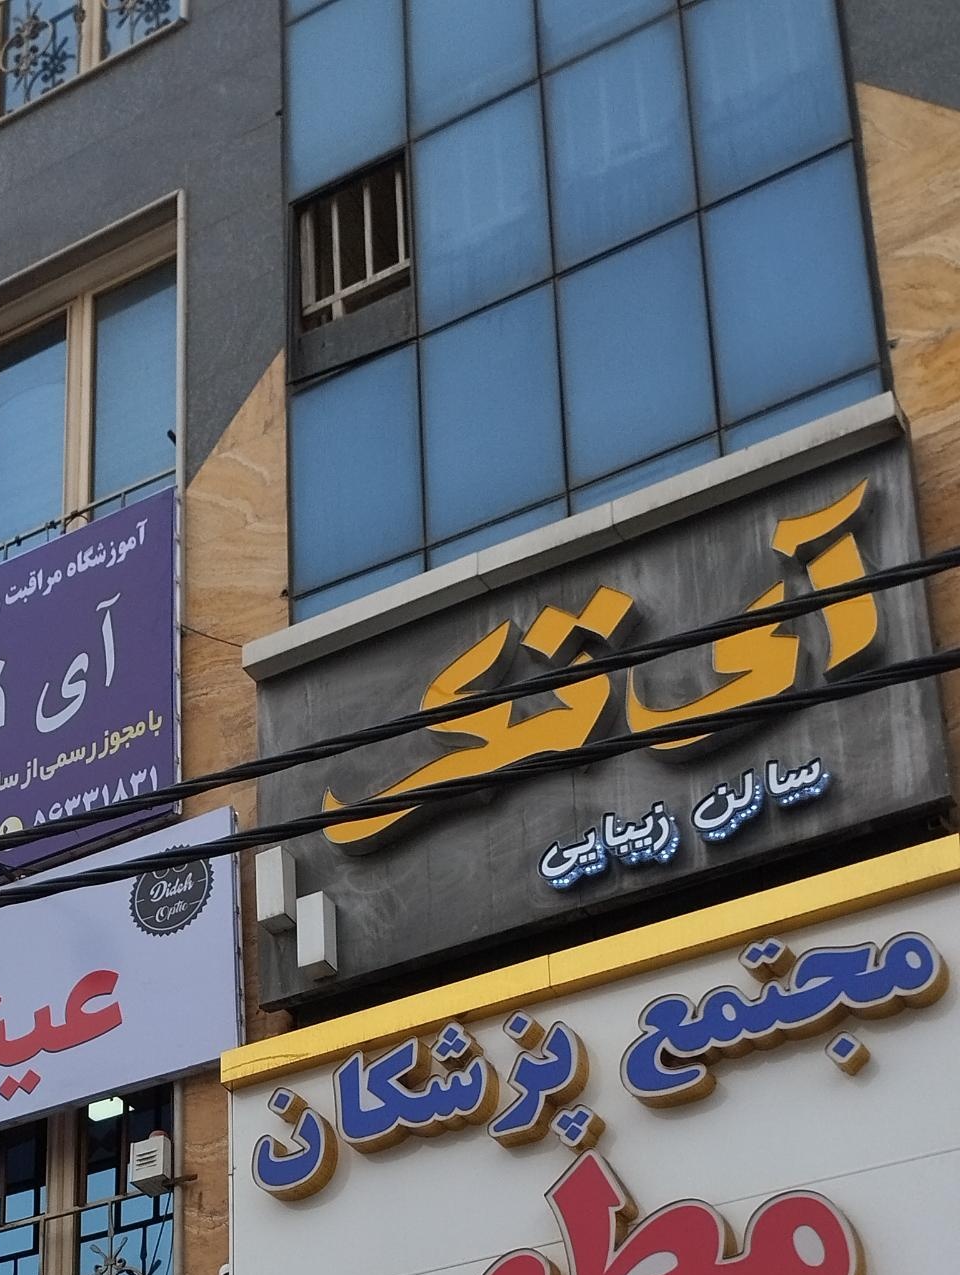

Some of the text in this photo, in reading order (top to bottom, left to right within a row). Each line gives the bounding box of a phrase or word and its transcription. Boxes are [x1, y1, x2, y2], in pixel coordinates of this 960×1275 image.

[67, 518, 149, 577] آموزشگاه
[5, 567, 62, 605] مراقبت
[36, 592, 120, 733] آی
[323, 478, 878, 845] آی تک
[100, 726, 146, 759] مجوز
[148, 710, 163, 736] با
[20, 759, 37, 789] از
[40, 740, 97, 781] رسمی
[538, 757, 824, 880] سالن زیبایی
[252, 932, 943, 1190] مجتمع پزشکان
